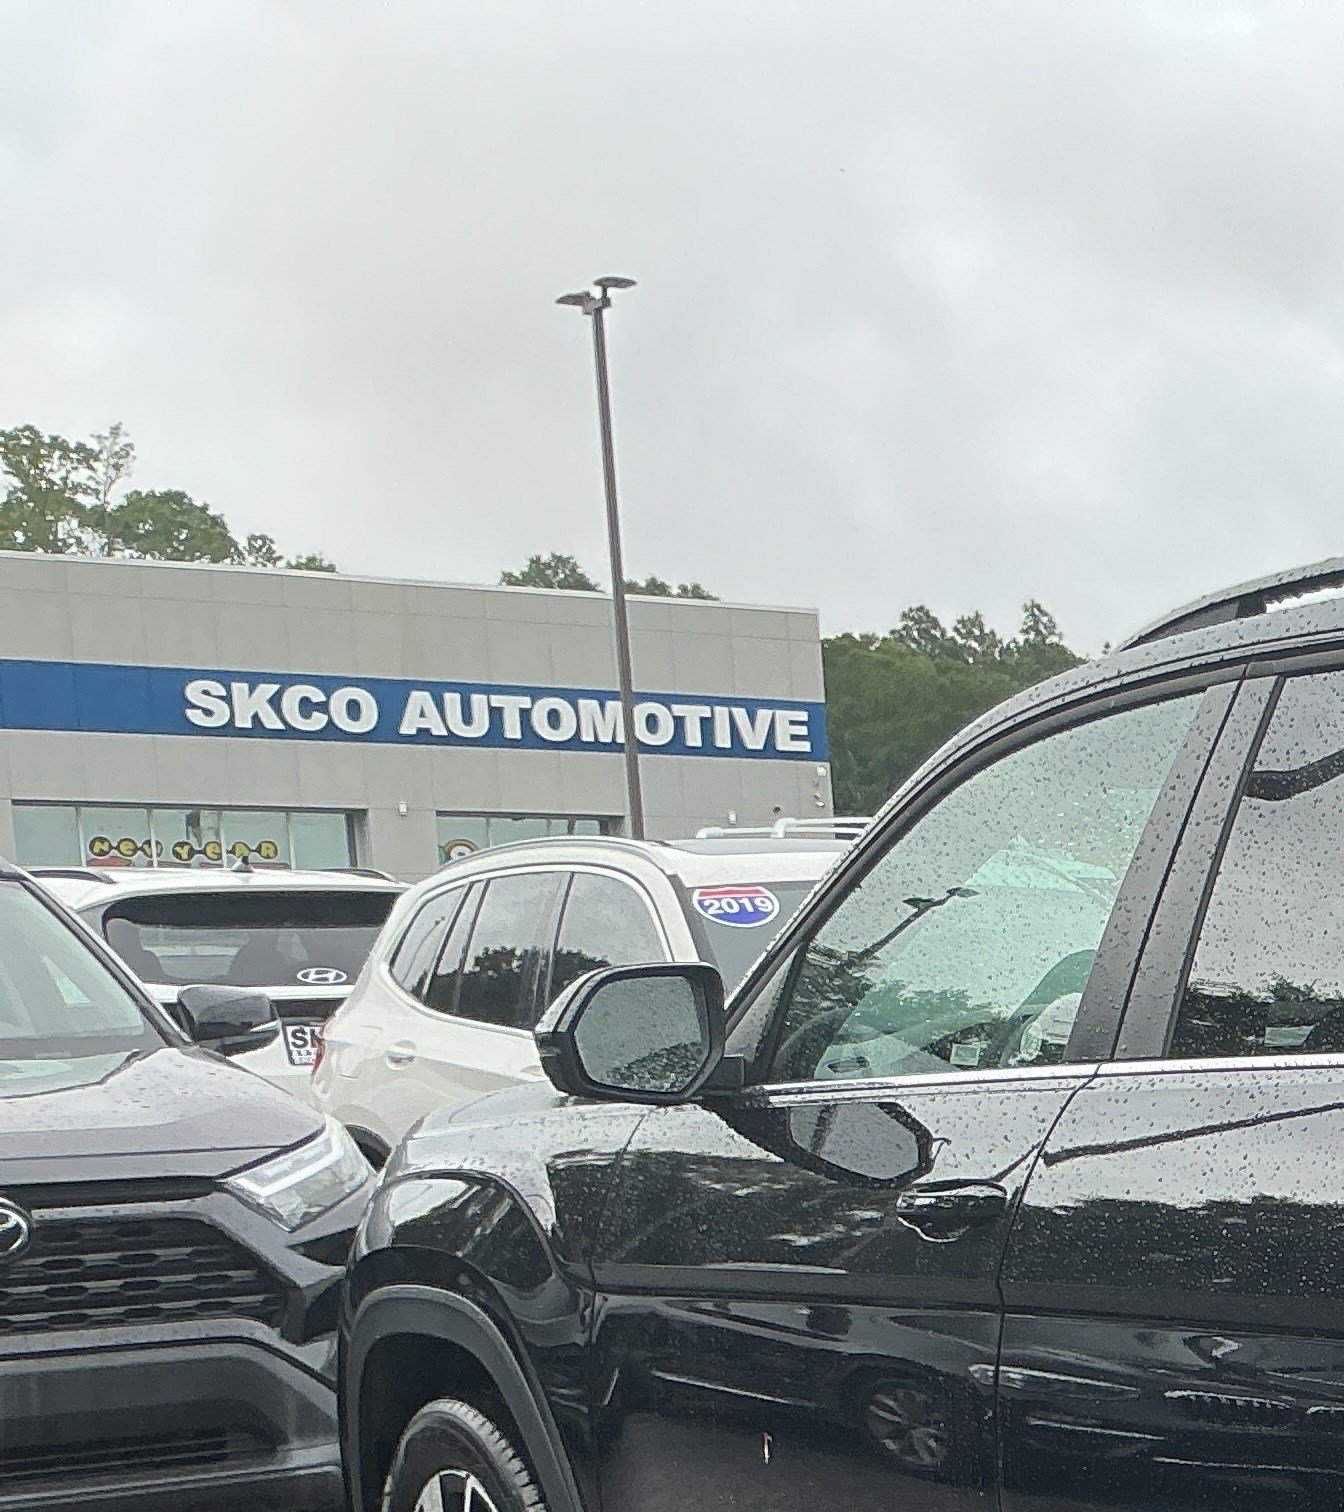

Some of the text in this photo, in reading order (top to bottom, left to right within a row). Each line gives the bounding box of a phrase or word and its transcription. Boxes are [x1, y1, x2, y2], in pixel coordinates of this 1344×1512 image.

[184, 680, 812, 753] SKCO AUTOMOTIVE
[703, 897, 774, 915] 2019
